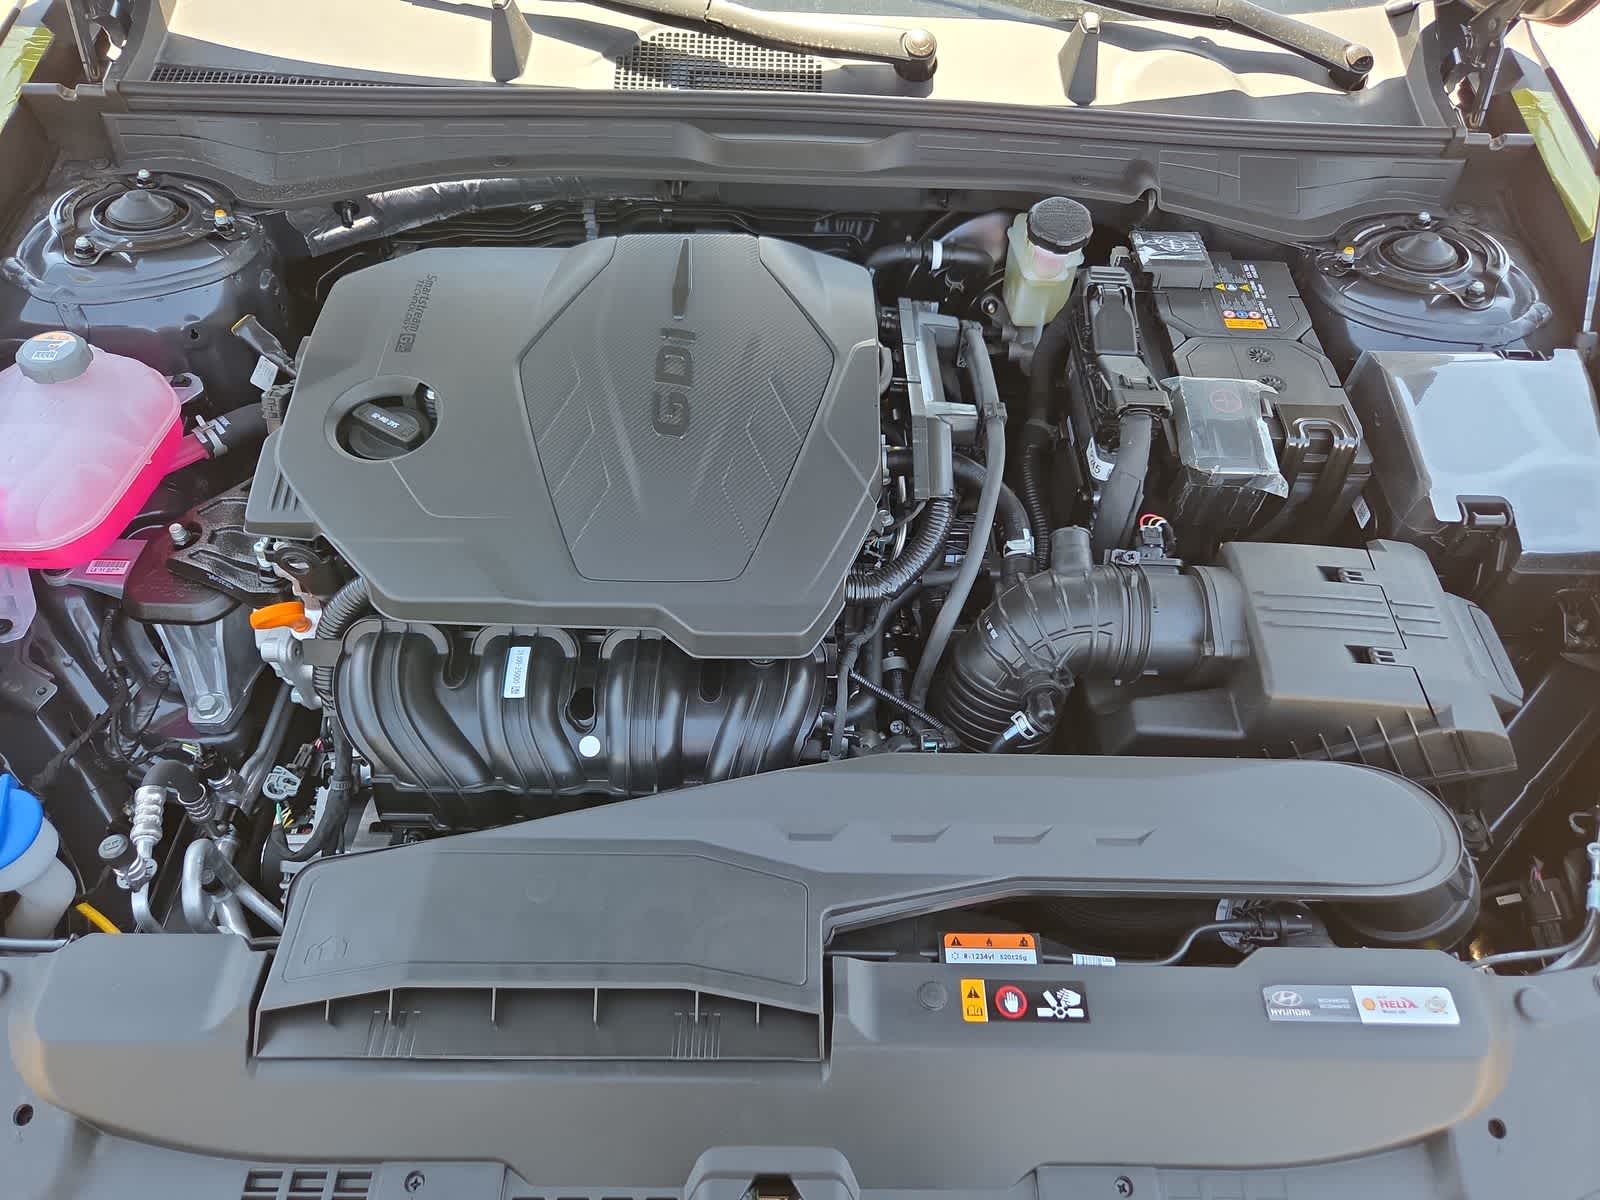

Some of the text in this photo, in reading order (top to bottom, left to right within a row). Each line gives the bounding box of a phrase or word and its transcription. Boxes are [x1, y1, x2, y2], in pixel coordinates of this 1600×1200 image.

[402, 279, 424, 332] TECHNOLOGY
[409, 273, 437, 332] Smartstream
[652, 327, 696, 440] GDI
[1270, 1008, 1311, 1016] HYUNDAI
[1380, 998, 1417, 1008] HELIX
